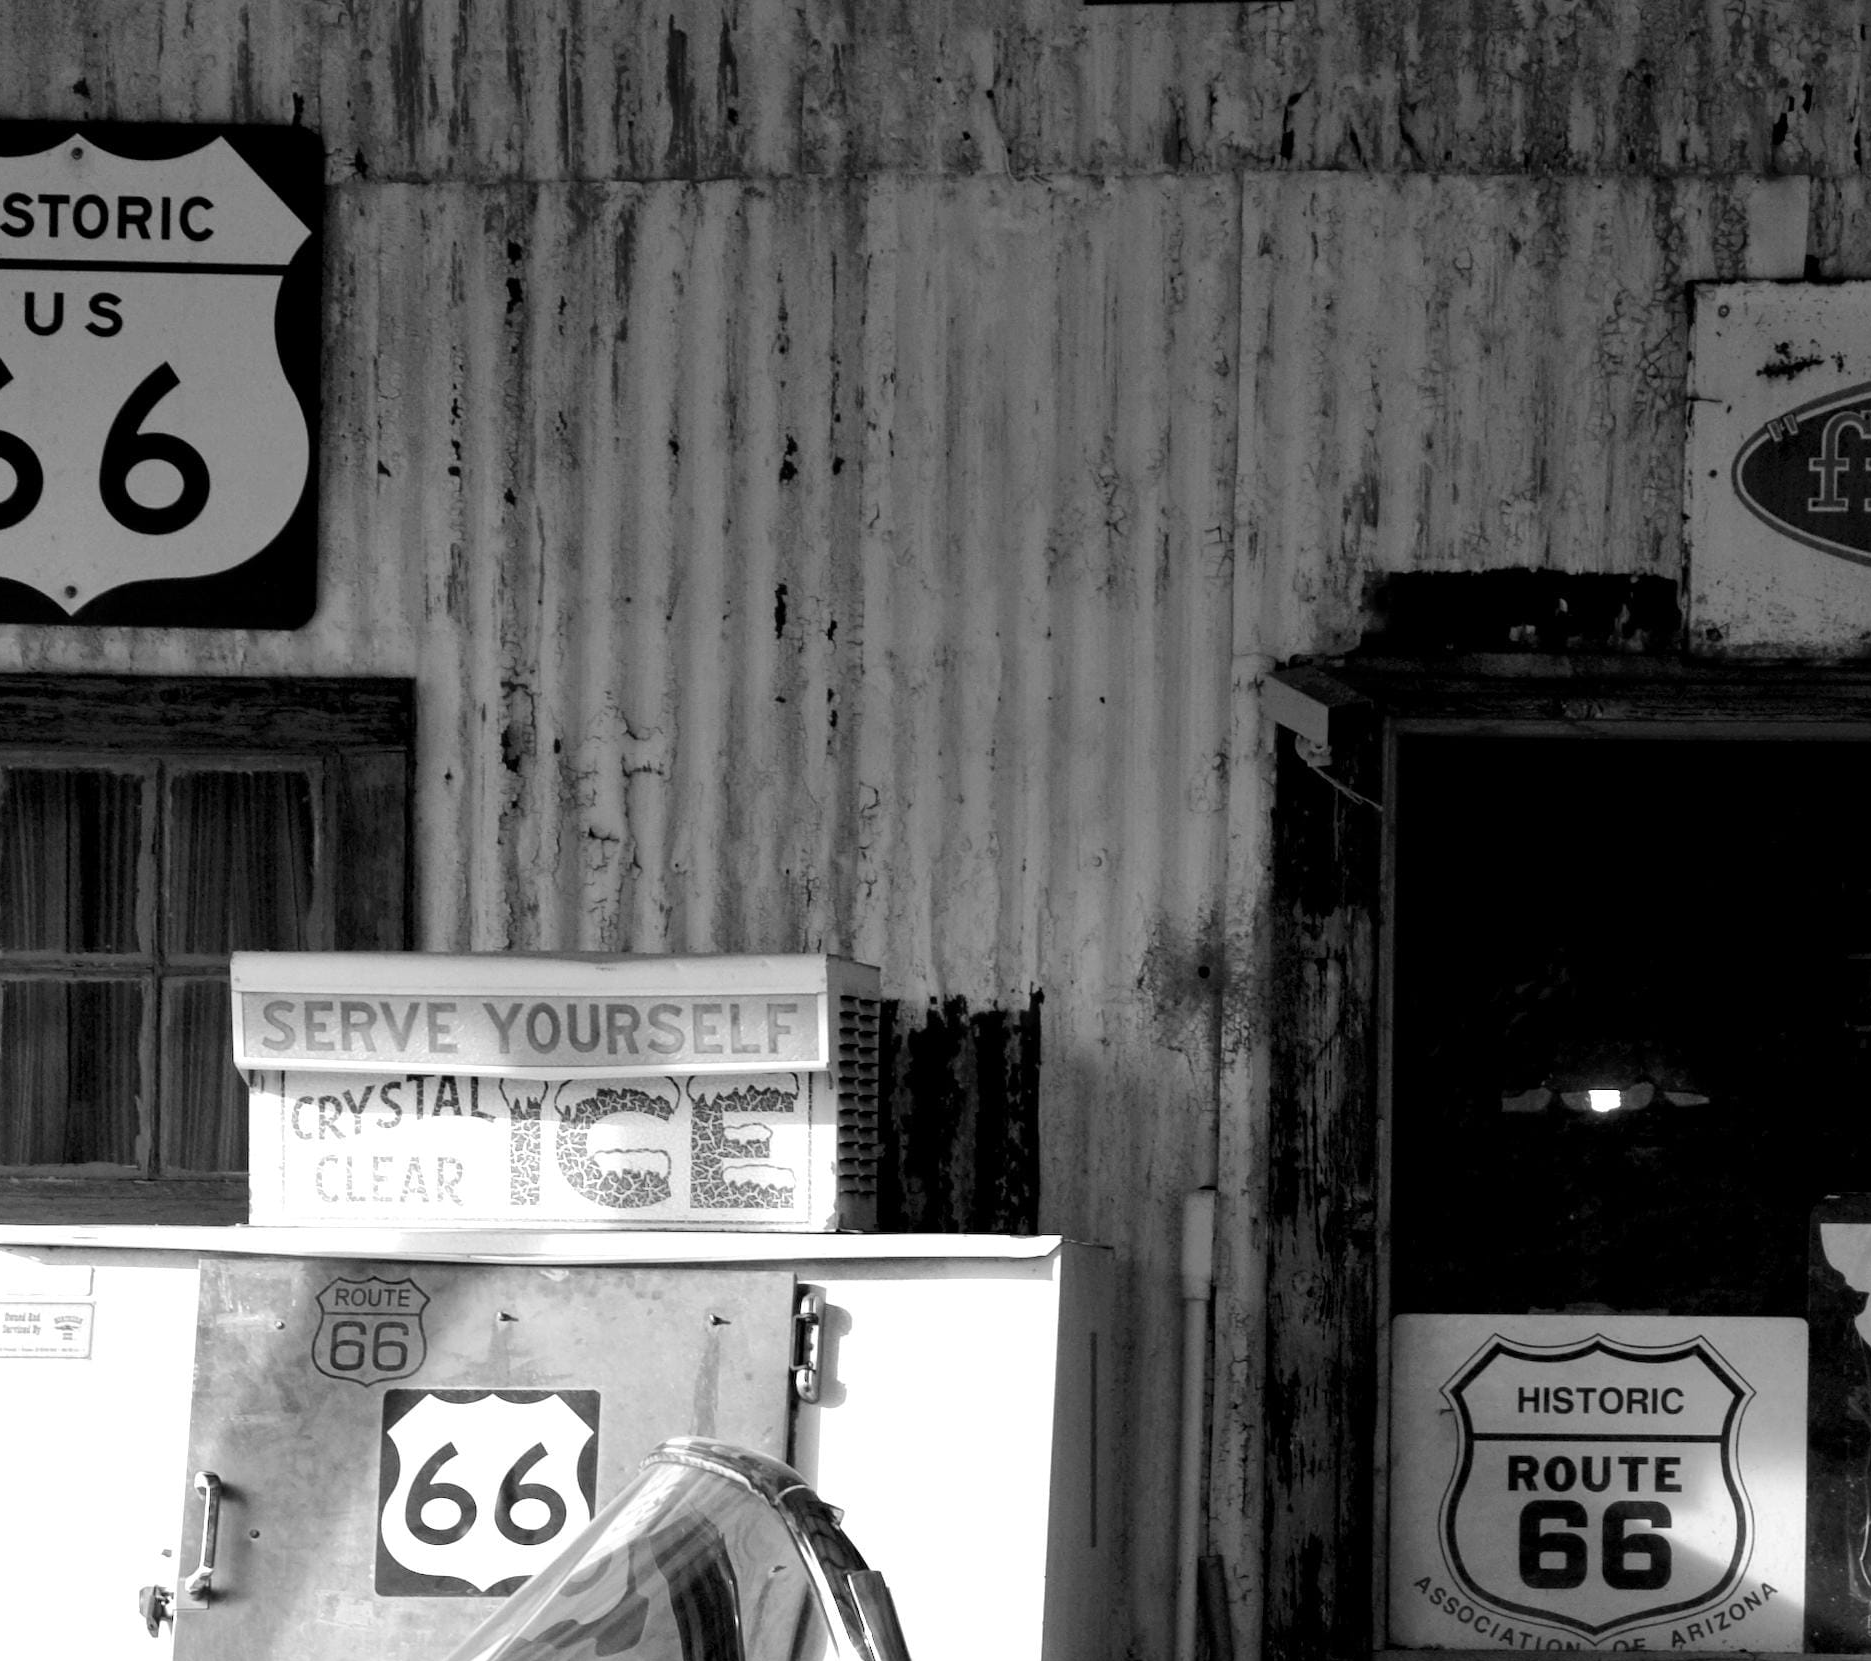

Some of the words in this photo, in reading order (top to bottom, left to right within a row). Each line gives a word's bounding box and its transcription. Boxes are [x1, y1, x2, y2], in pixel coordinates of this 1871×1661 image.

[23, 291, 124, 338] US
[261, 1000, 459, 1054] SERVE
[482, 1000, 800, 1055] YOURSELF
[290, 1073, 496, 1142] CRYSTAL
[314, 1154, 465, 1208] CLEAR
[333, 1288, 411, 1309] ROUTE
[329, 1320, 410, 1372] 66
[1517, 1386, 1685, 1415] HISTORIC
[405, 1441, 568, 1547] 66
[1507, 1454, 1683, 1494] ROUTE
[1518, 1499, 1673, 1591] 66
[1413, 1575, 1581, 1652] ASSOCIATION
[1613, 1638, 1647, 1652] OF
[1670, 1581, 1779, 1649] ARIZONA
